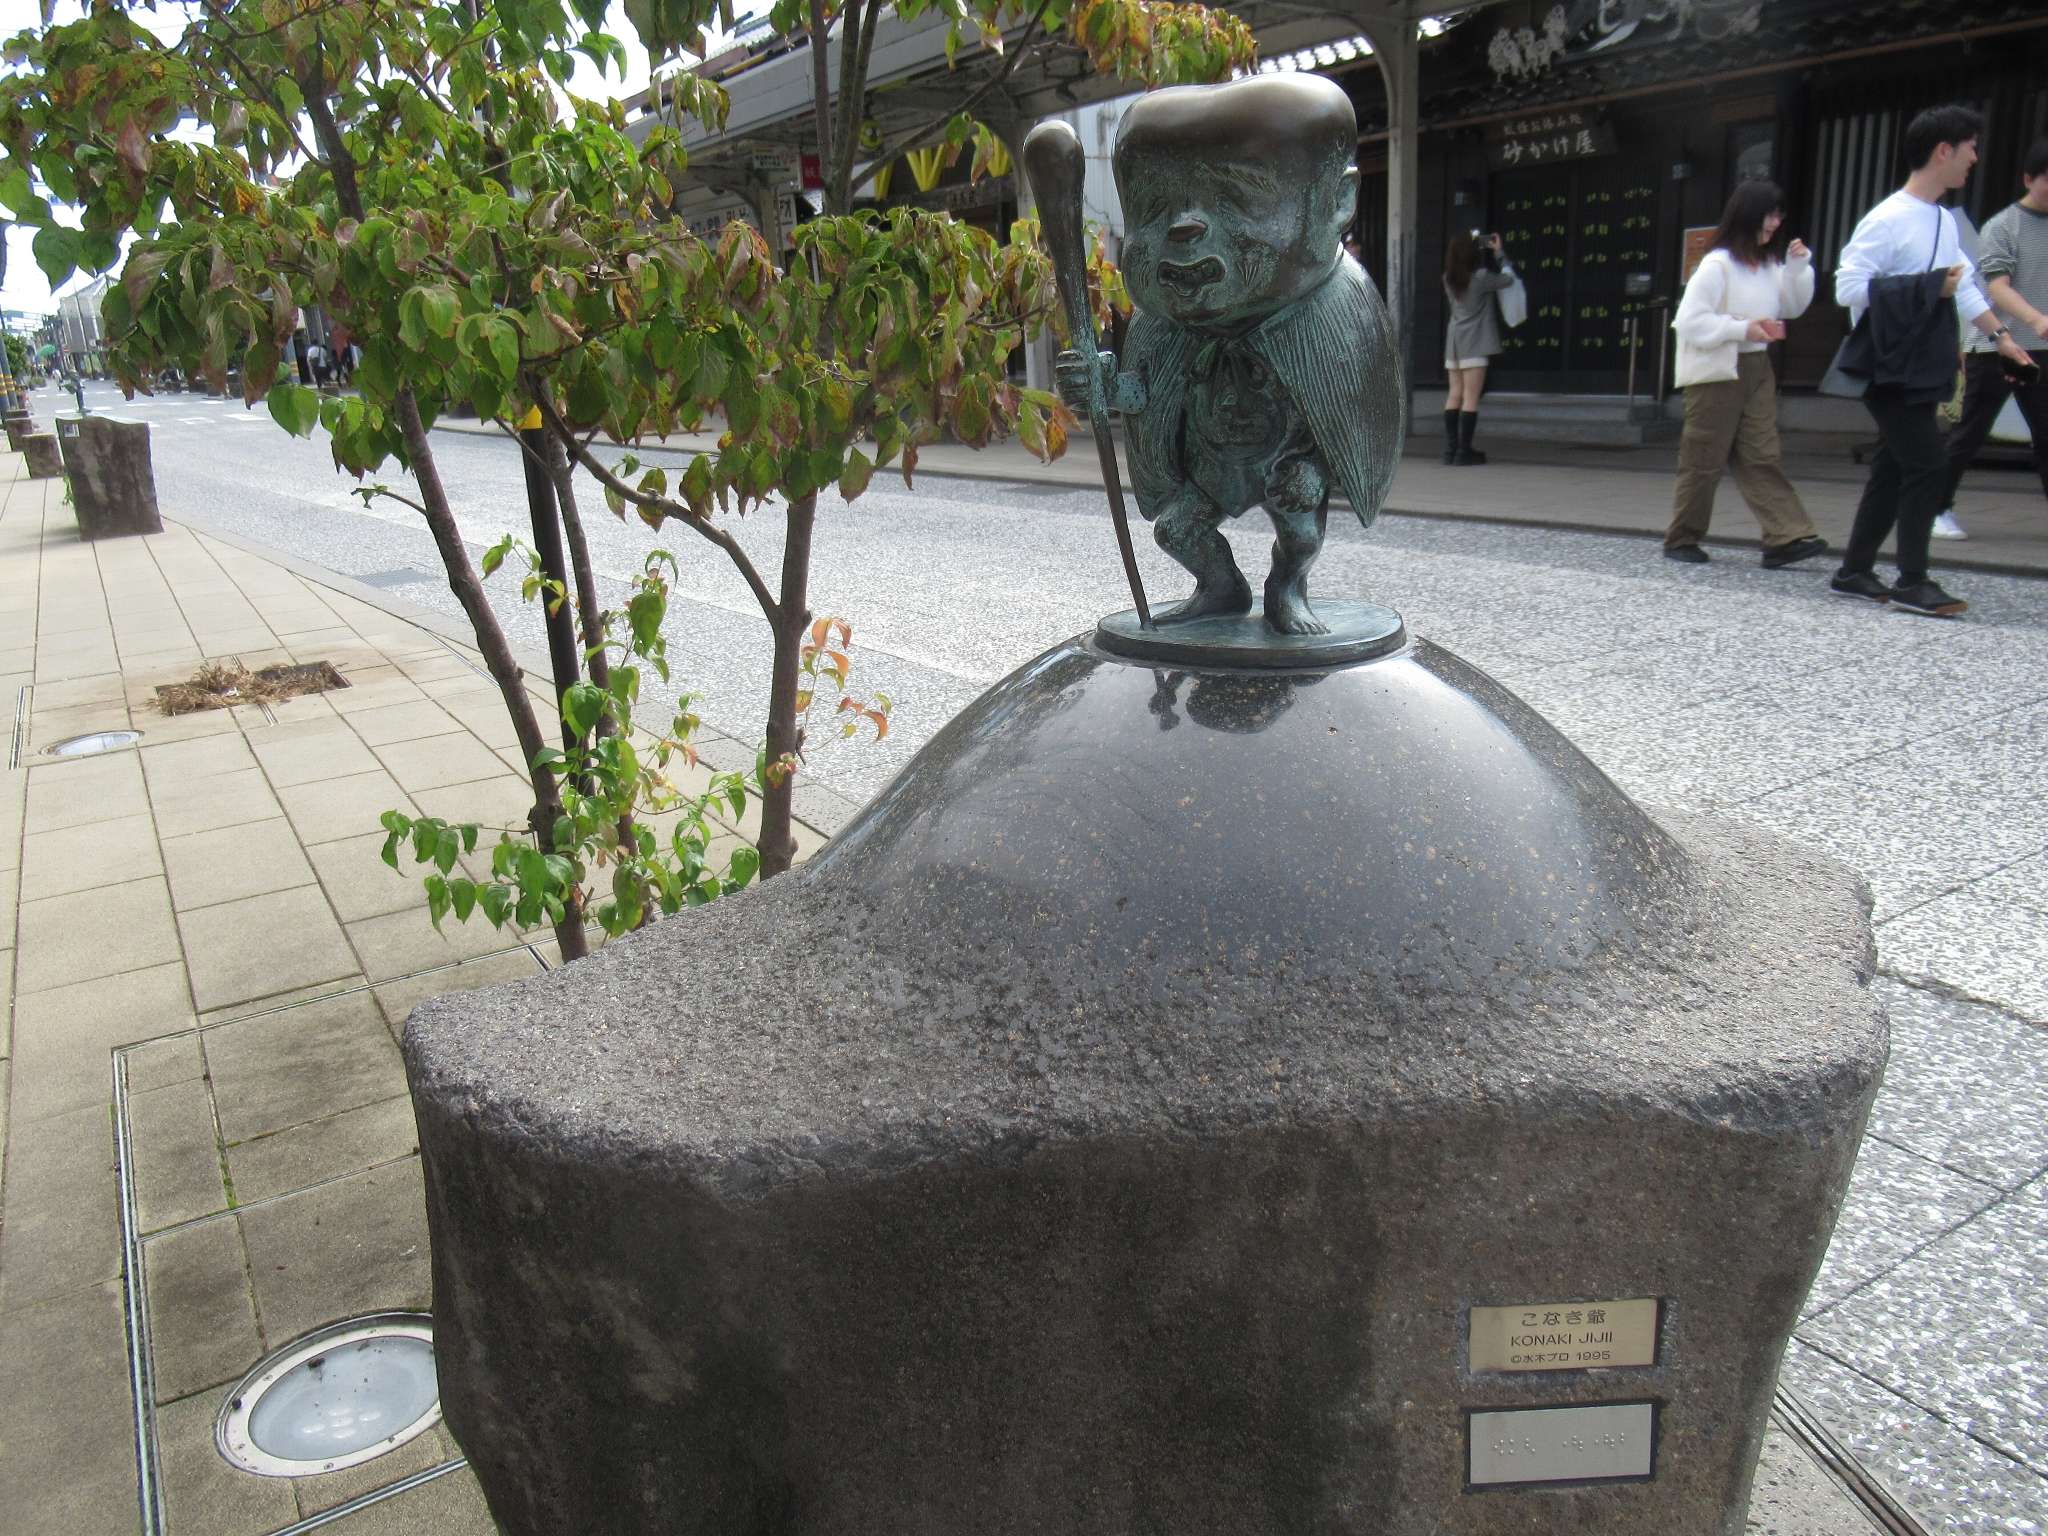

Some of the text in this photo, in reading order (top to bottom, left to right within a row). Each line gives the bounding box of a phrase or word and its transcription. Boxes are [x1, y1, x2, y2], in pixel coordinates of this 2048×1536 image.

[1503, 129, 1597, 165] 砂かけ屋
[1521, 1309, 1607, 1327] こなき爺
[1510, 1331, 1613, 1347] KONAKI JIJII
[1576, 1350, 1611, 1361] 1995
